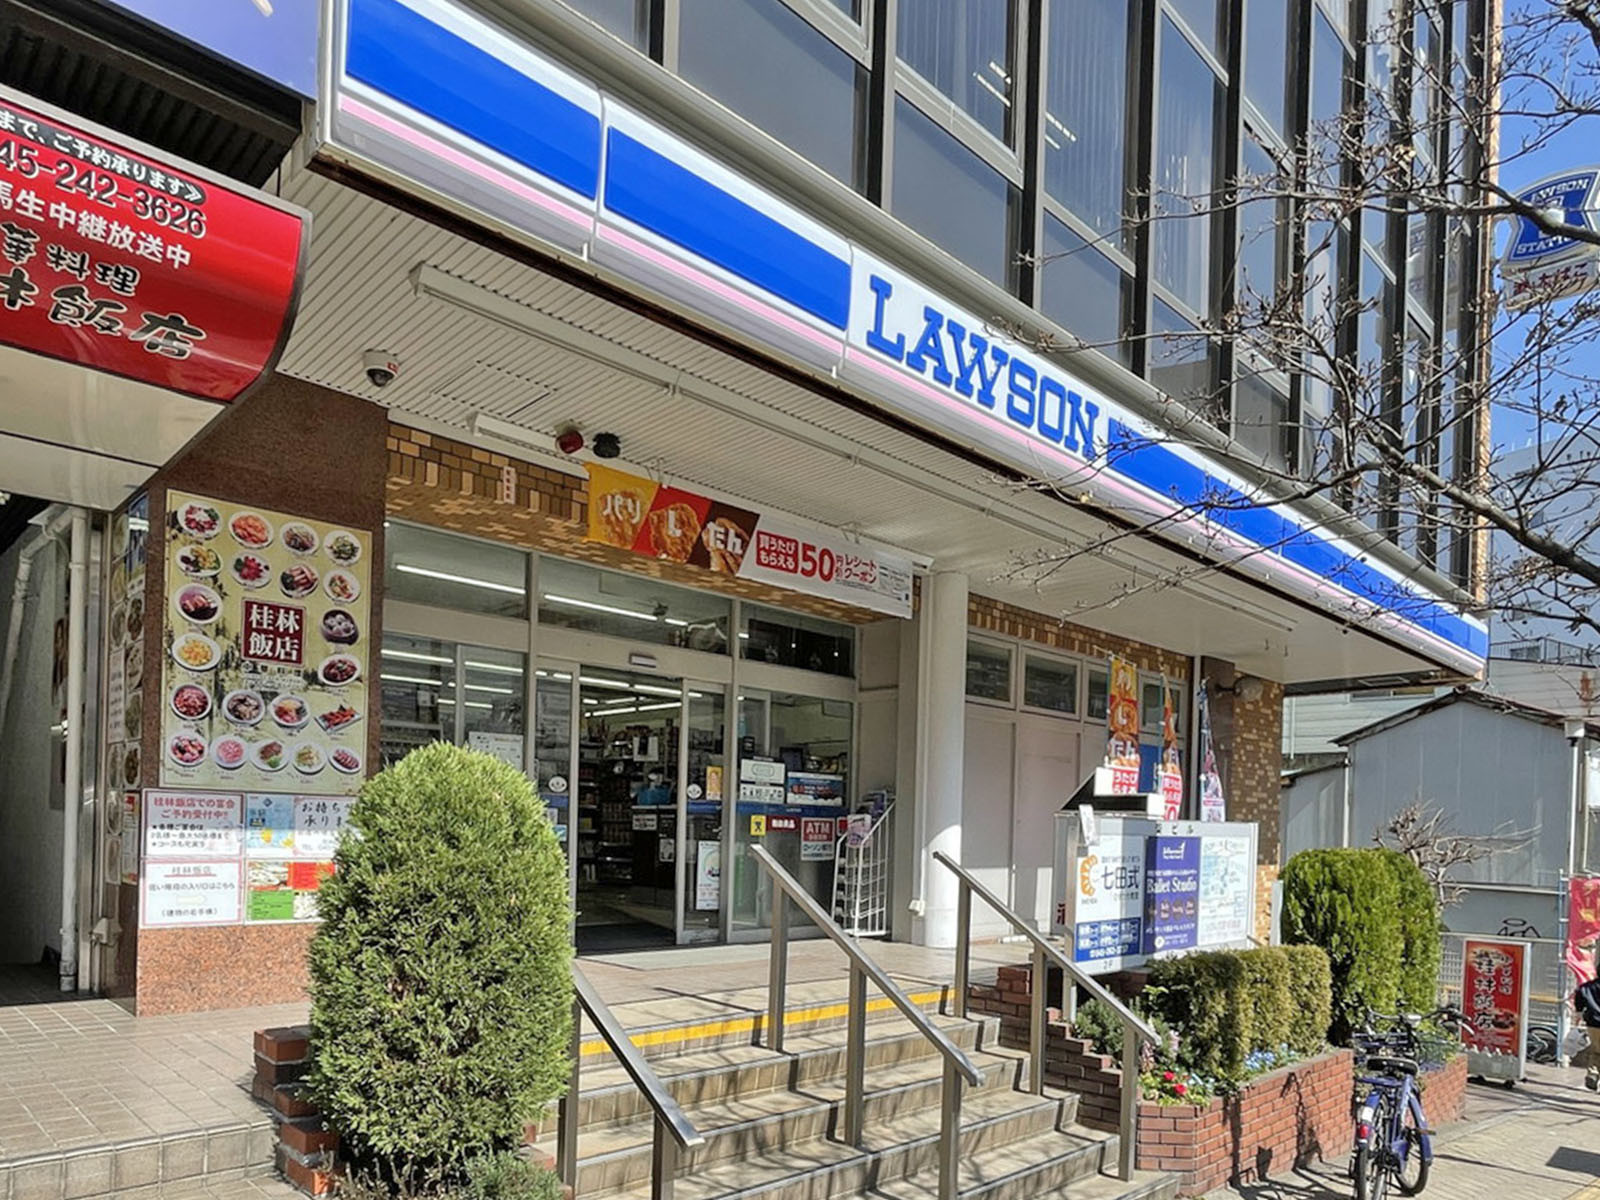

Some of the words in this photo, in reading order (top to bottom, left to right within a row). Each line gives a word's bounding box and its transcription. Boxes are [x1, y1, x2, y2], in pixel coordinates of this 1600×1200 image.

[866, 274, 1099, 460] LAWSON
[759, 534, 796, 555] 買うたび
[759, 550, 796, 570] もらえる
[800, 542, 834, 582] 50
[844, 553, 877, 571] レシート
[844, 567, 877, 584] クーポン
[248, 603, 300, 634] 桂林
[248, 631, 300, 661] 飯店
[805, 822, 831, 834] ATM
[1101, 865, 1140, 890] 七田式
[1172, 876, 1197, 892] Studio
